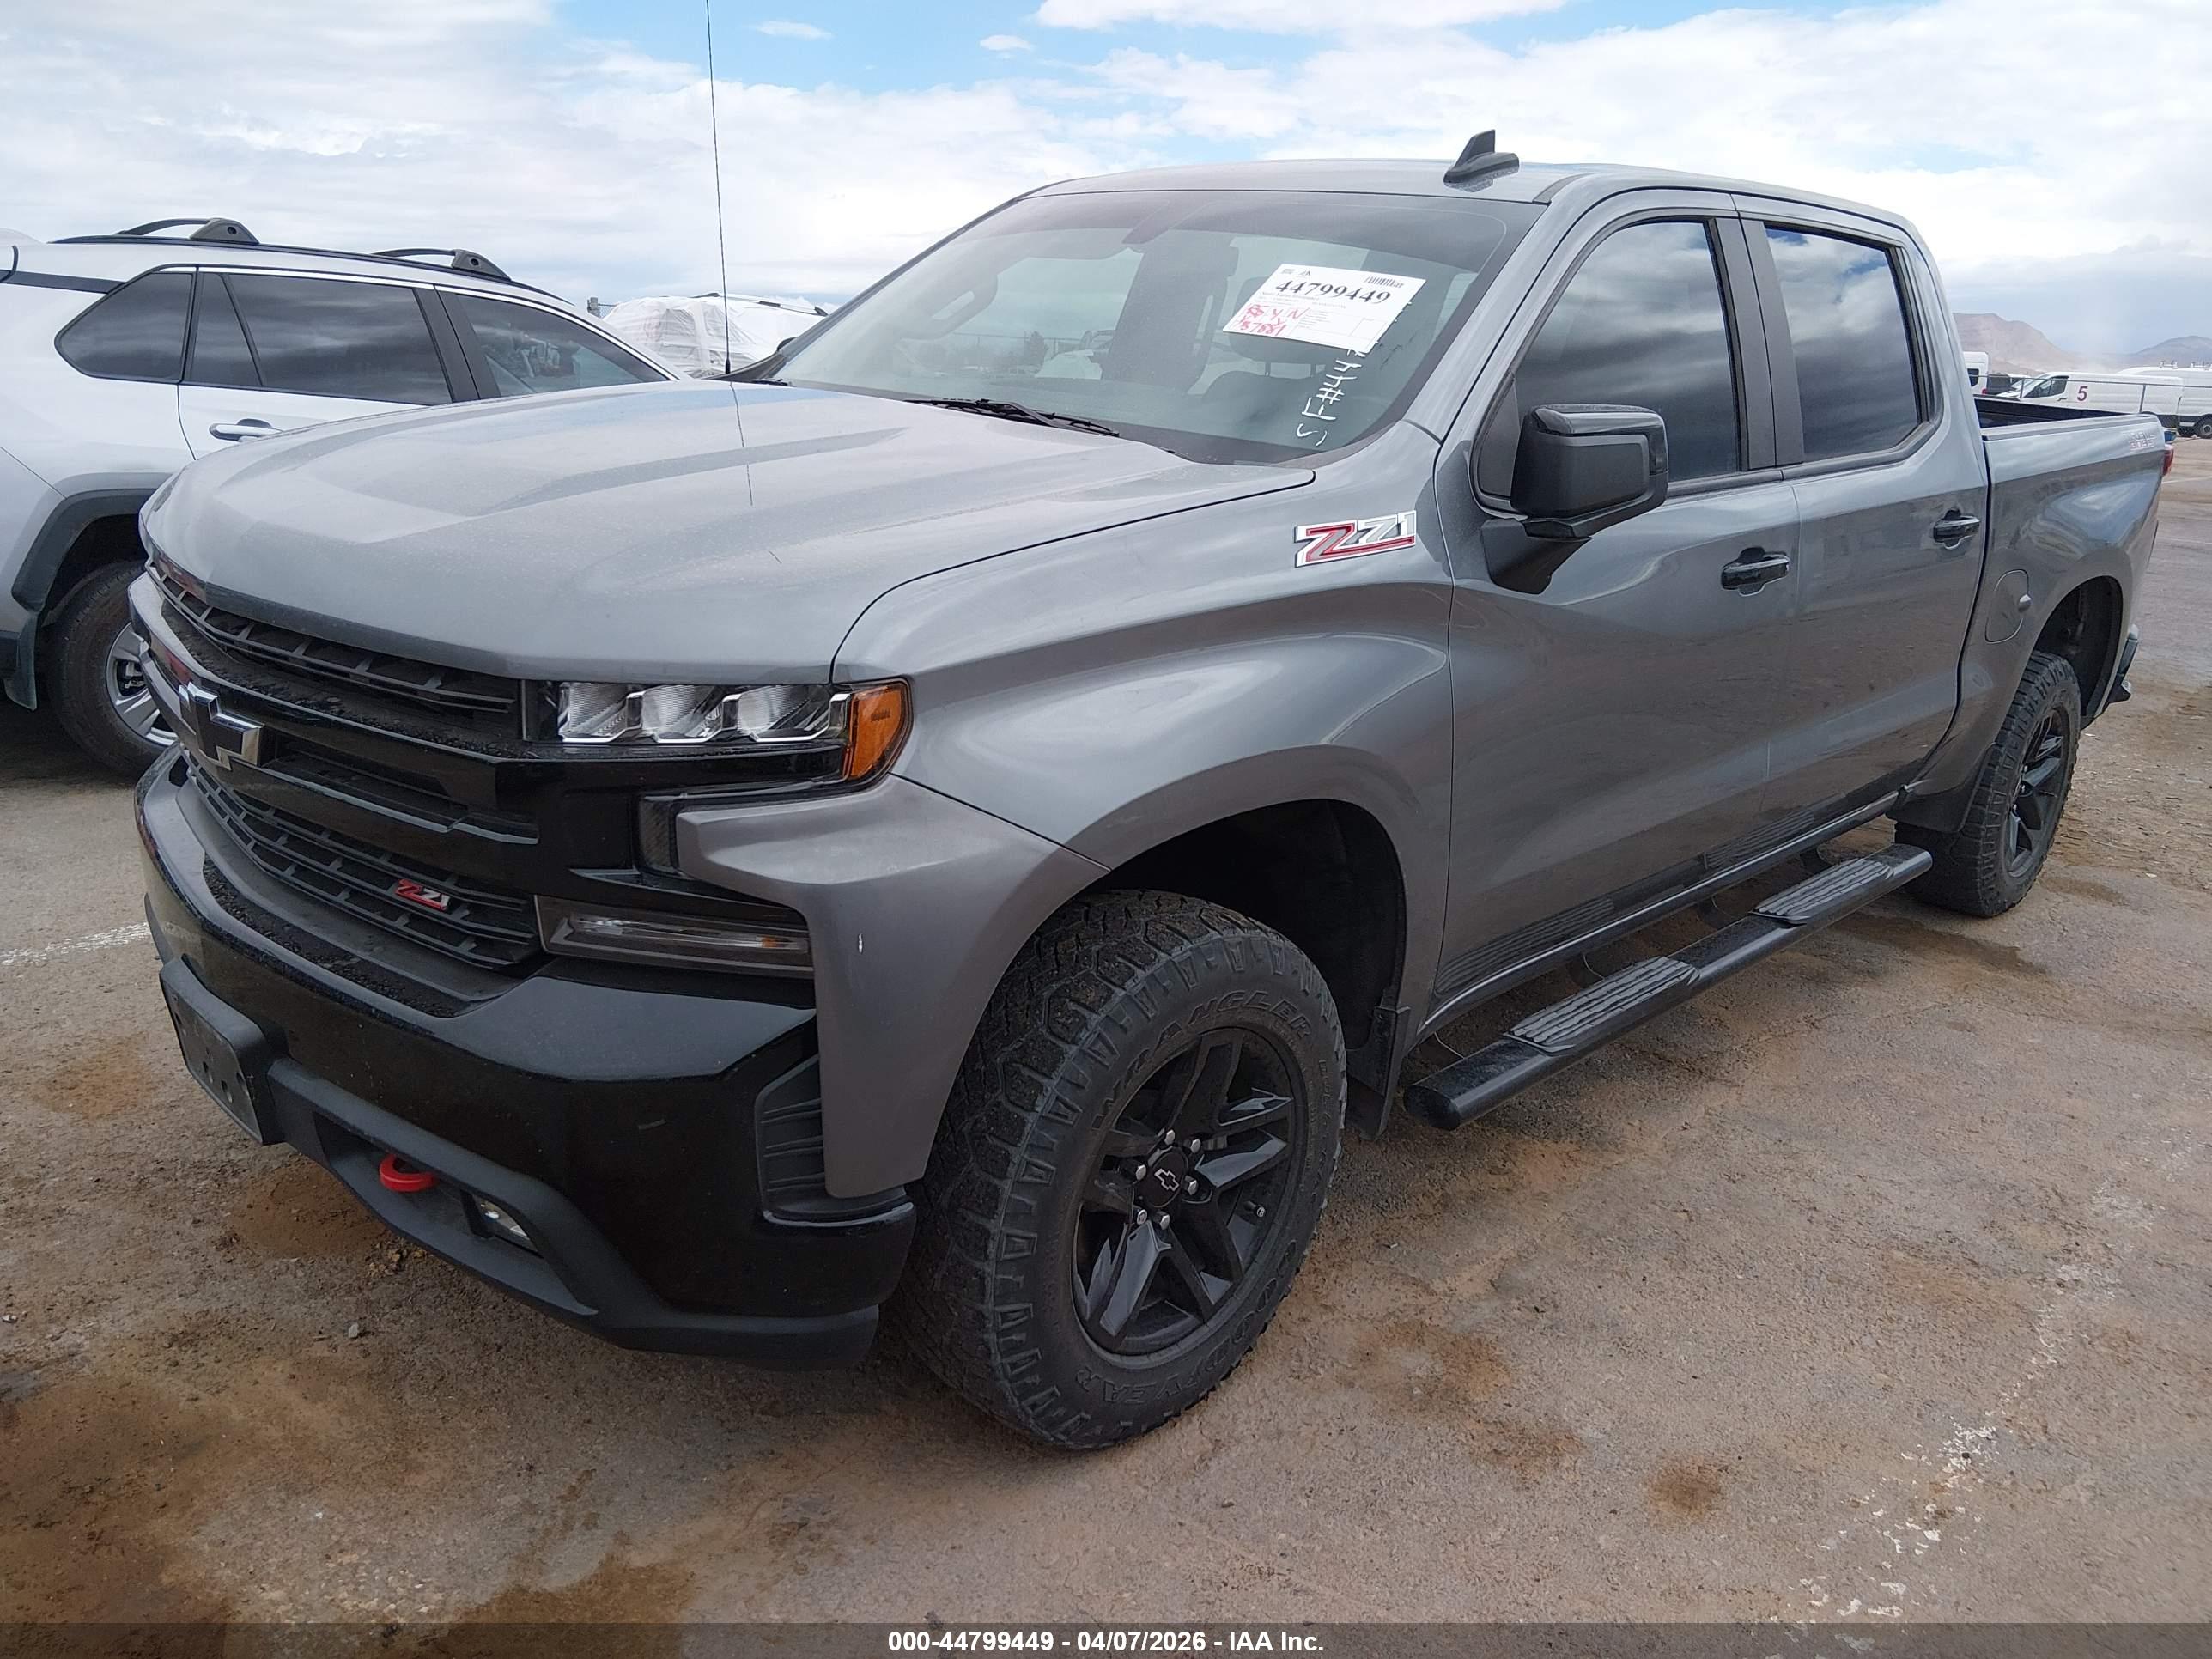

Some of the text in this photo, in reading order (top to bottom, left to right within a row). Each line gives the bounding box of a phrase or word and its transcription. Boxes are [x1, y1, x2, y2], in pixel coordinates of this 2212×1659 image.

[1275, 280, 1391, 304] 44799449
[2076, 386, 2089, 402] 5
[1295, 510, 1417, 568] Z71
[394, 878, 450, 911] Z71
